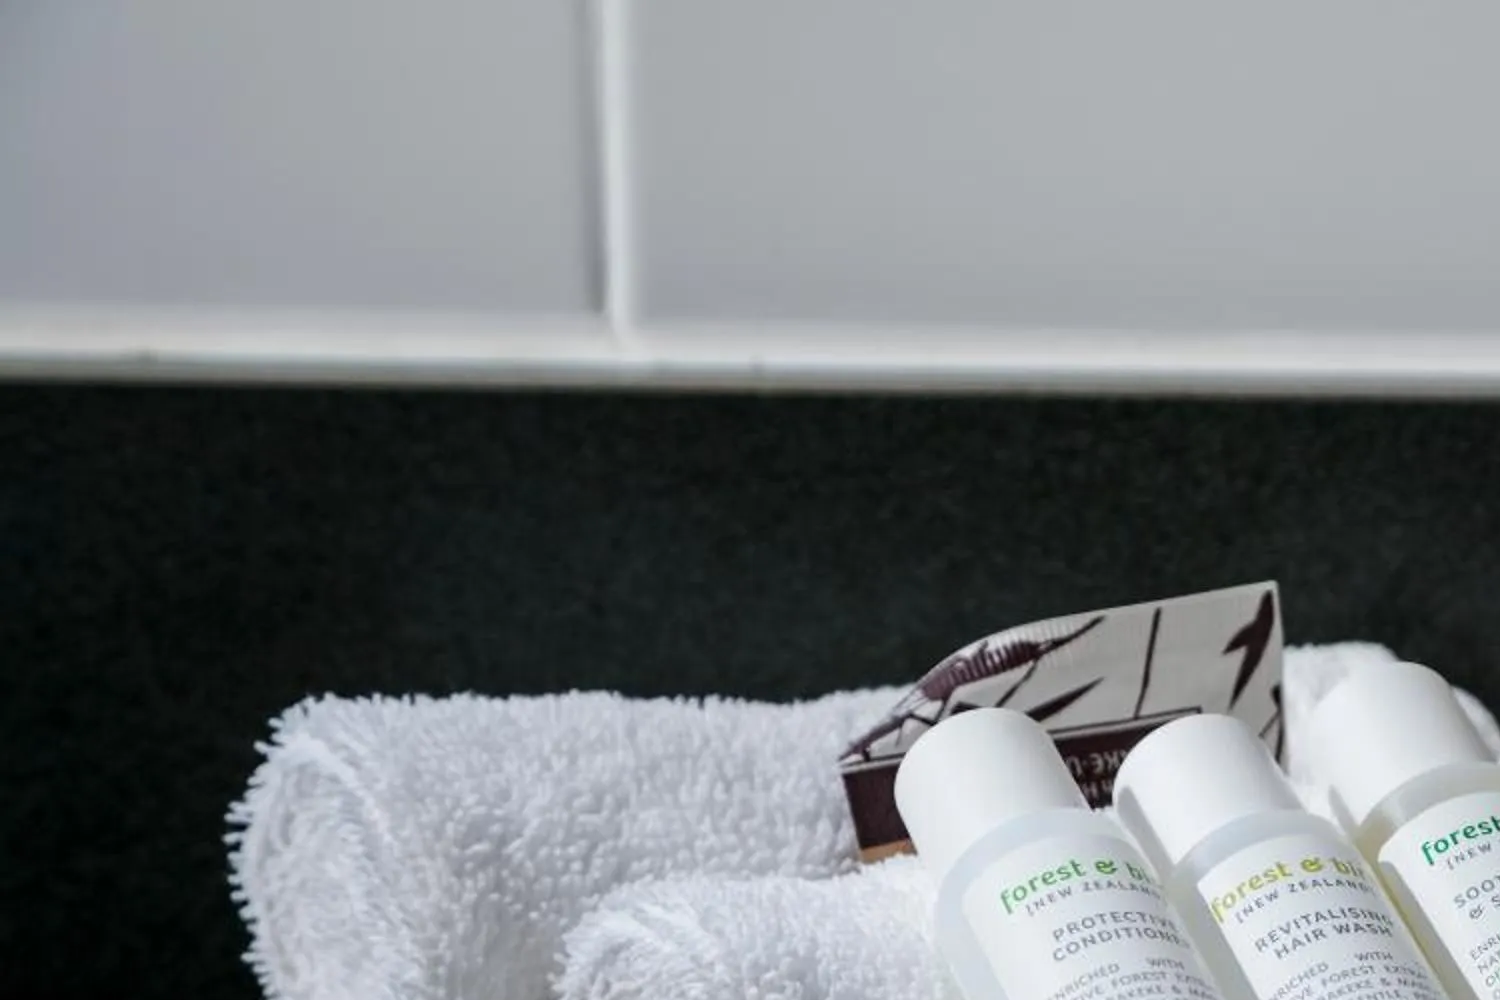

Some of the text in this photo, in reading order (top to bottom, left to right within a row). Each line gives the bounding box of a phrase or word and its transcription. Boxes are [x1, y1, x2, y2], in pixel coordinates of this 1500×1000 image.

[1000, 859, 1086, 914] forest
[1094, 860, 1118, 874] &
[1210, 857, 1366, 923] forest & bir
[1233, 890, 1279, 924] [NEW
[1468, 905, 1485, 920] &
[1053, 927, 1190, 961] CONDITIONE
[1254, 907, 1394, 953] REVITALISING
[1274, 923, 1394, 960] HAIR WASH
[1354, 952, 1394, 961] WITH
[1321, 965, 1376, 987] FOREST
